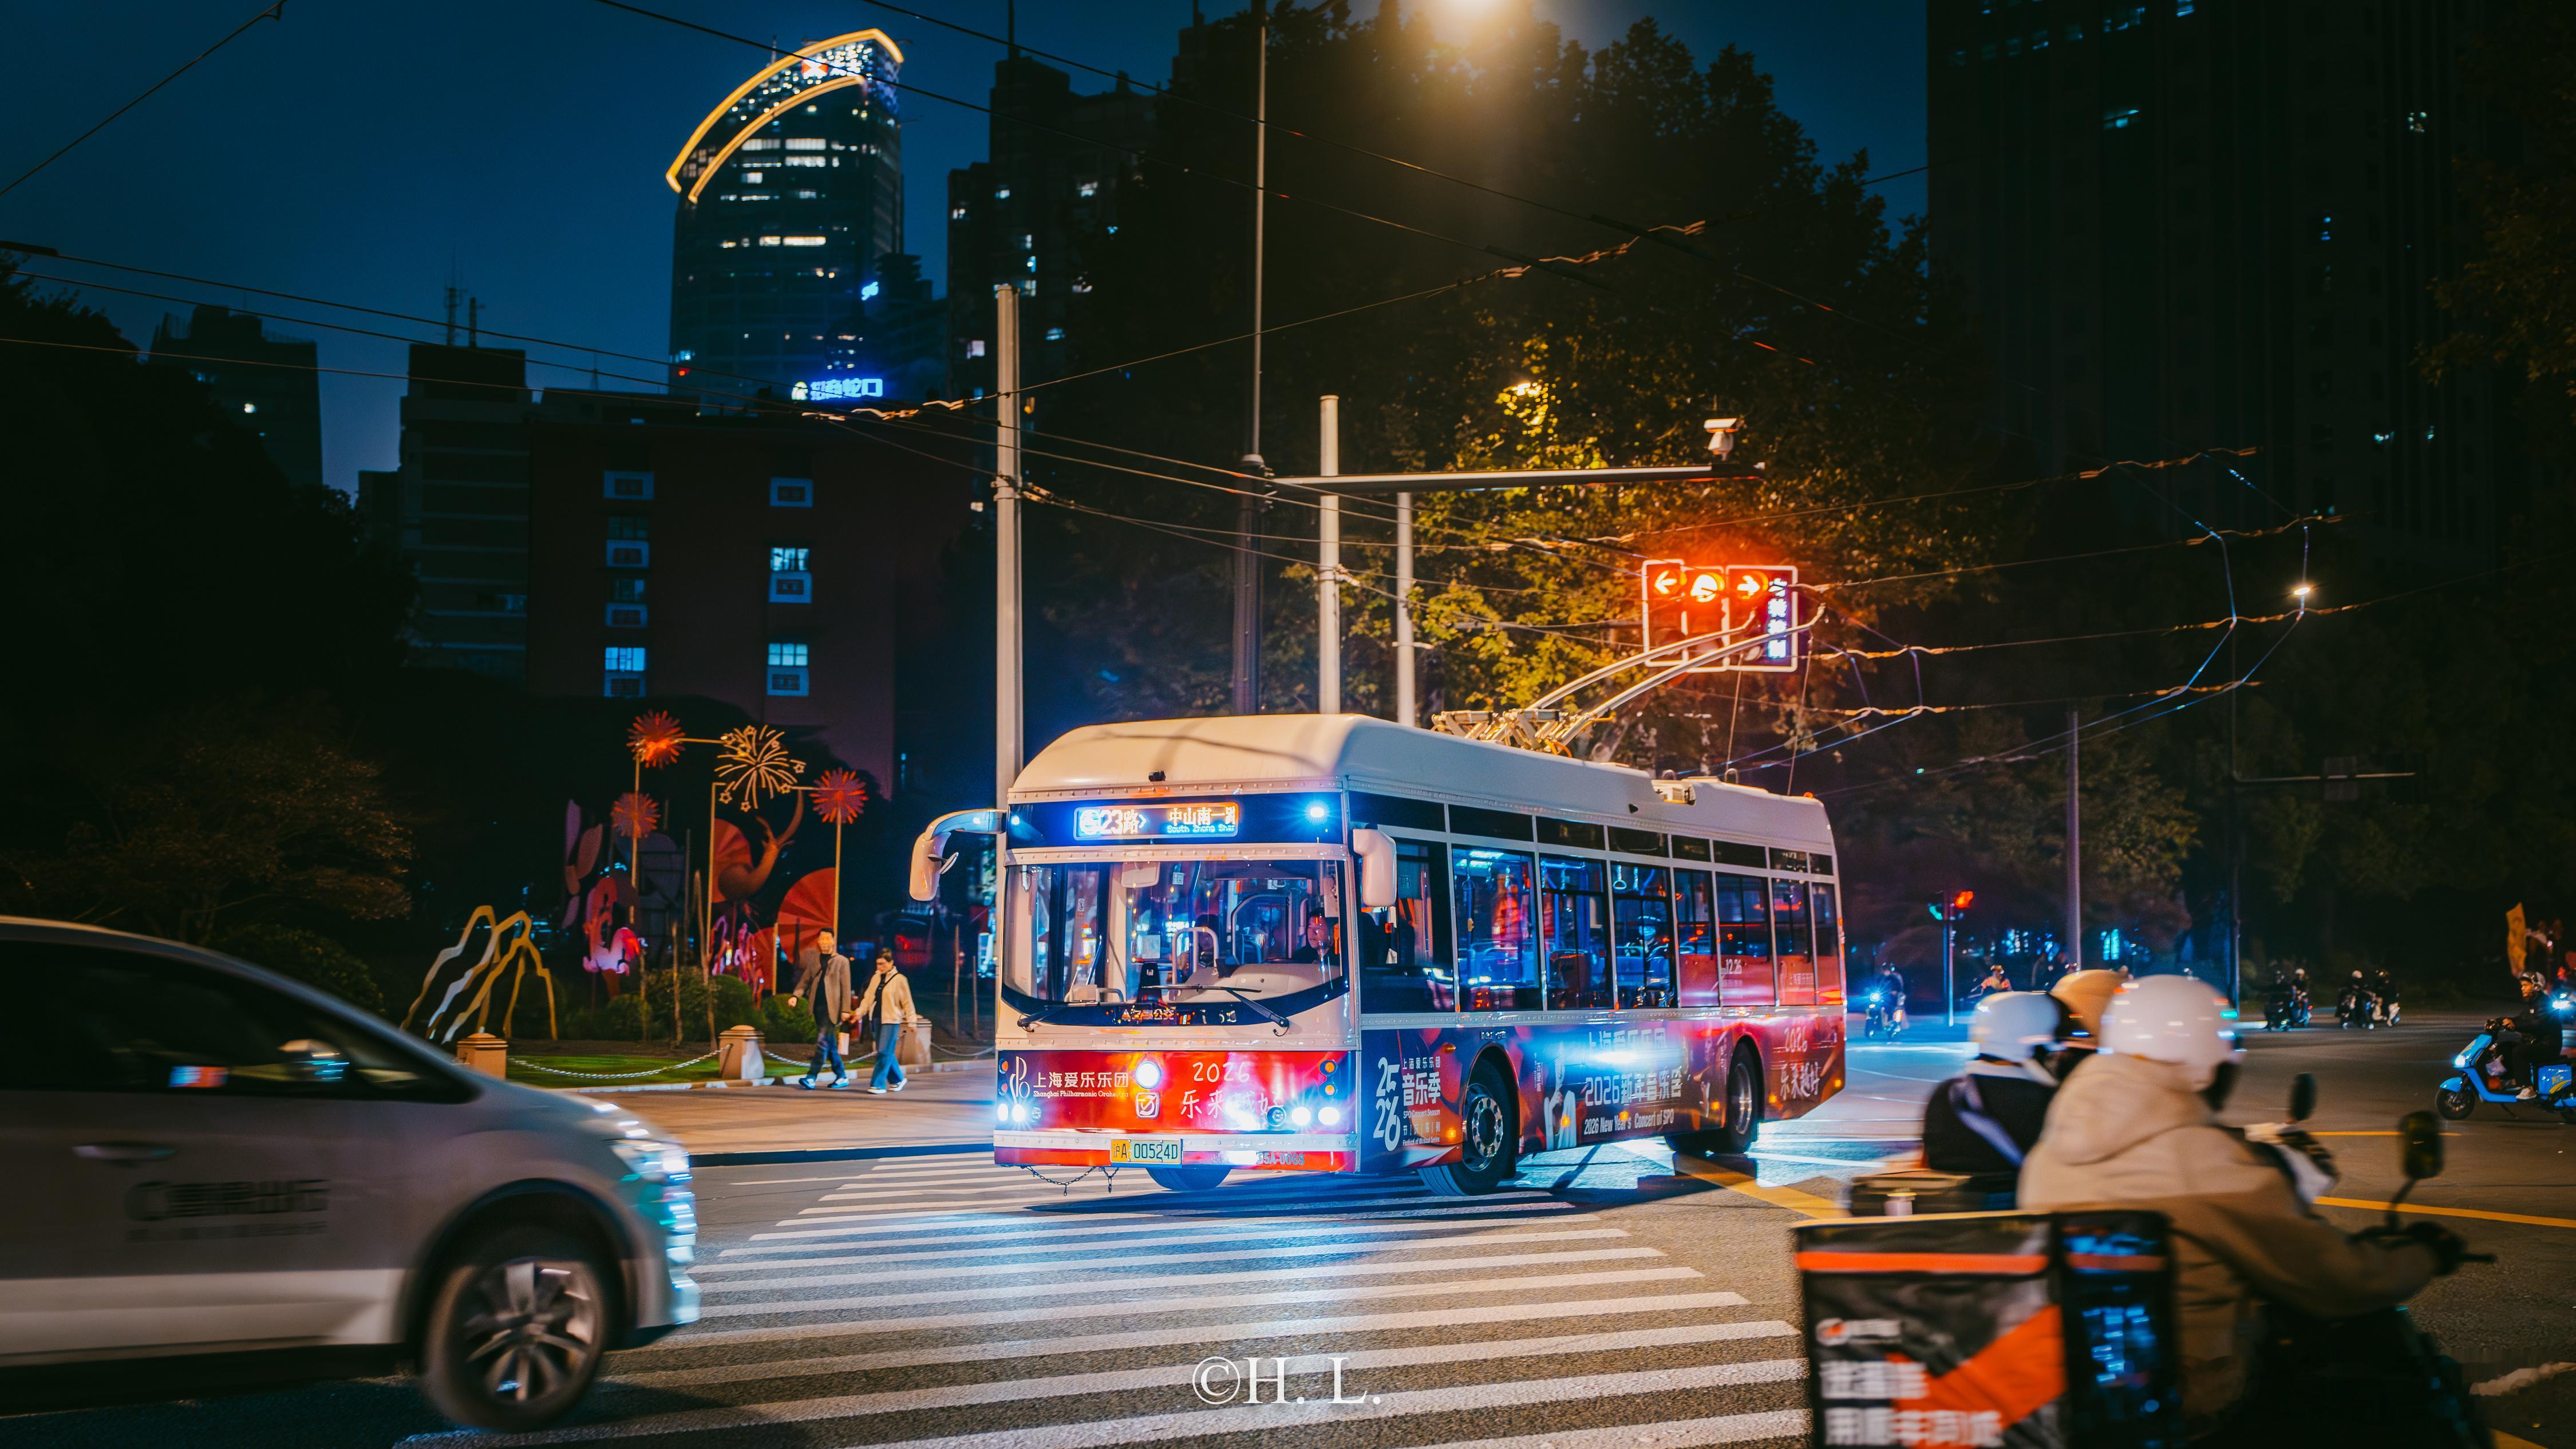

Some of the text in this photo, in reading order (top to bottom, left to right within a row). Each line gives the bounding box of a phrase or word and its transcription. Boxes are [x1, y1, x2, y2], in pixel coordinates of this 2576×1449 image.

[1167, 824, 1190, 833] South
[1192, 824, 1215, 833] Zhong
[1784, 1026, 1808, 1053] 2026
[1402, 1056, 1441, 1070] 上海爱乐乐团
[1033, 1072, 1129, 1088] 上海爱乐乐团
[1192, 1061, 1250, 1083] 2026
[1033, 1090, 1059, 1099] Shanghai
[1060, 1090, 1097, 1098] Philharmonic
[1402, 1072, 1441, 1106] 音乐季
[1585, 1067, 1682, 1107] 2026新年音乐会
[1403, 1110, 1412, 1119] SPO
[1584, 1118, 1599, 1135] 2026
[1600, 1116, 1613, 1132] New
[1634, 1111, 1656, 1129] Concert
[1657, 1109, 1662, 1126] of
[1662, 1108, 1674, 1126] SPO
[1134, 1143, 1178, 1160] 00524D
